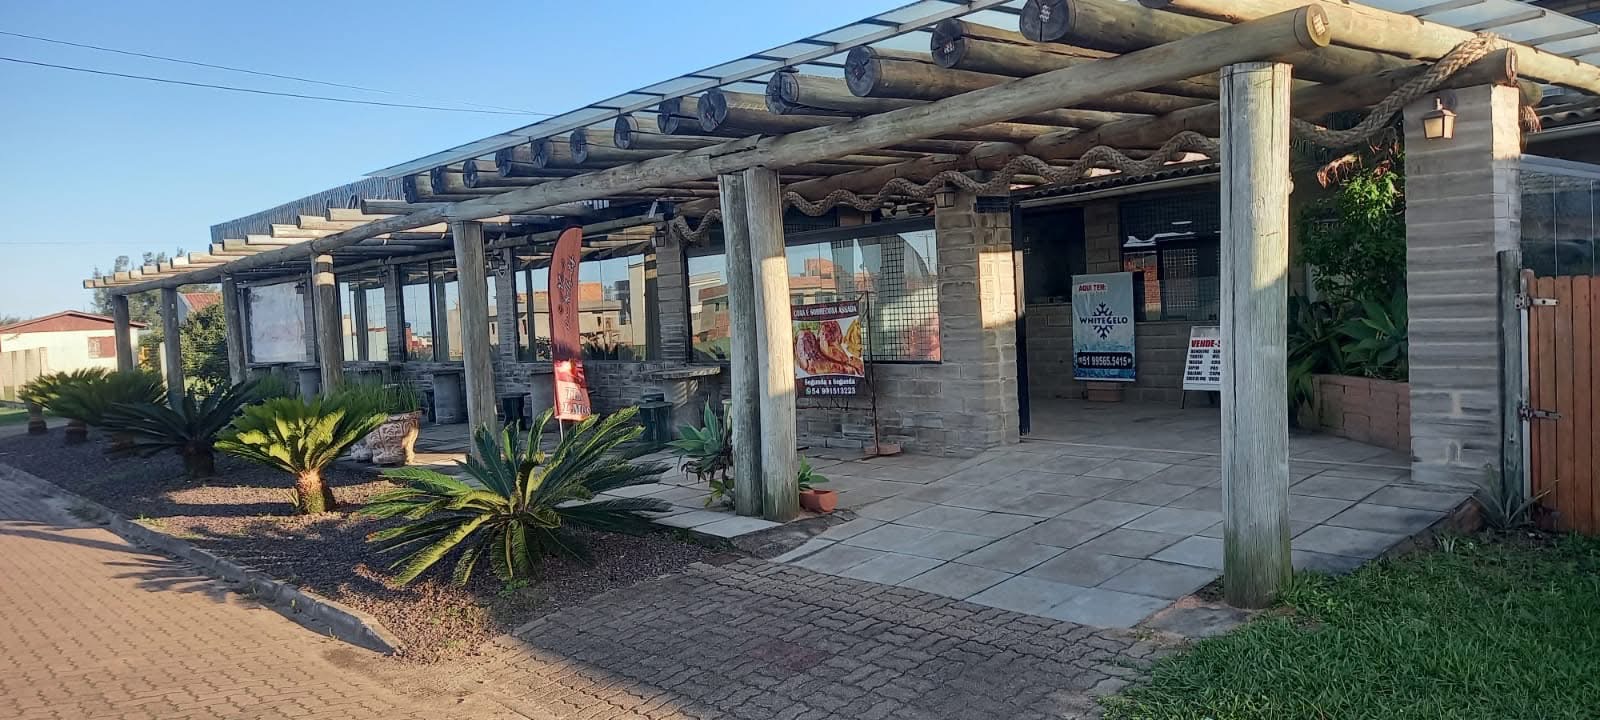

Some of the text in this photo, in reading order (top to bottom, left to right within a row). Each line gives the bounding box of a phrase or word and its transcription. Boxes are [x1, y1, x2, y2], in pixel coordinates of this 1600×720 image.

[1079, 284, 1092, 292] AQUI
[1080, 317, 1128, 325] WHITEGELO
[1082, 355, 1090, 366] 51
[811, 387, 820, 395] 54
